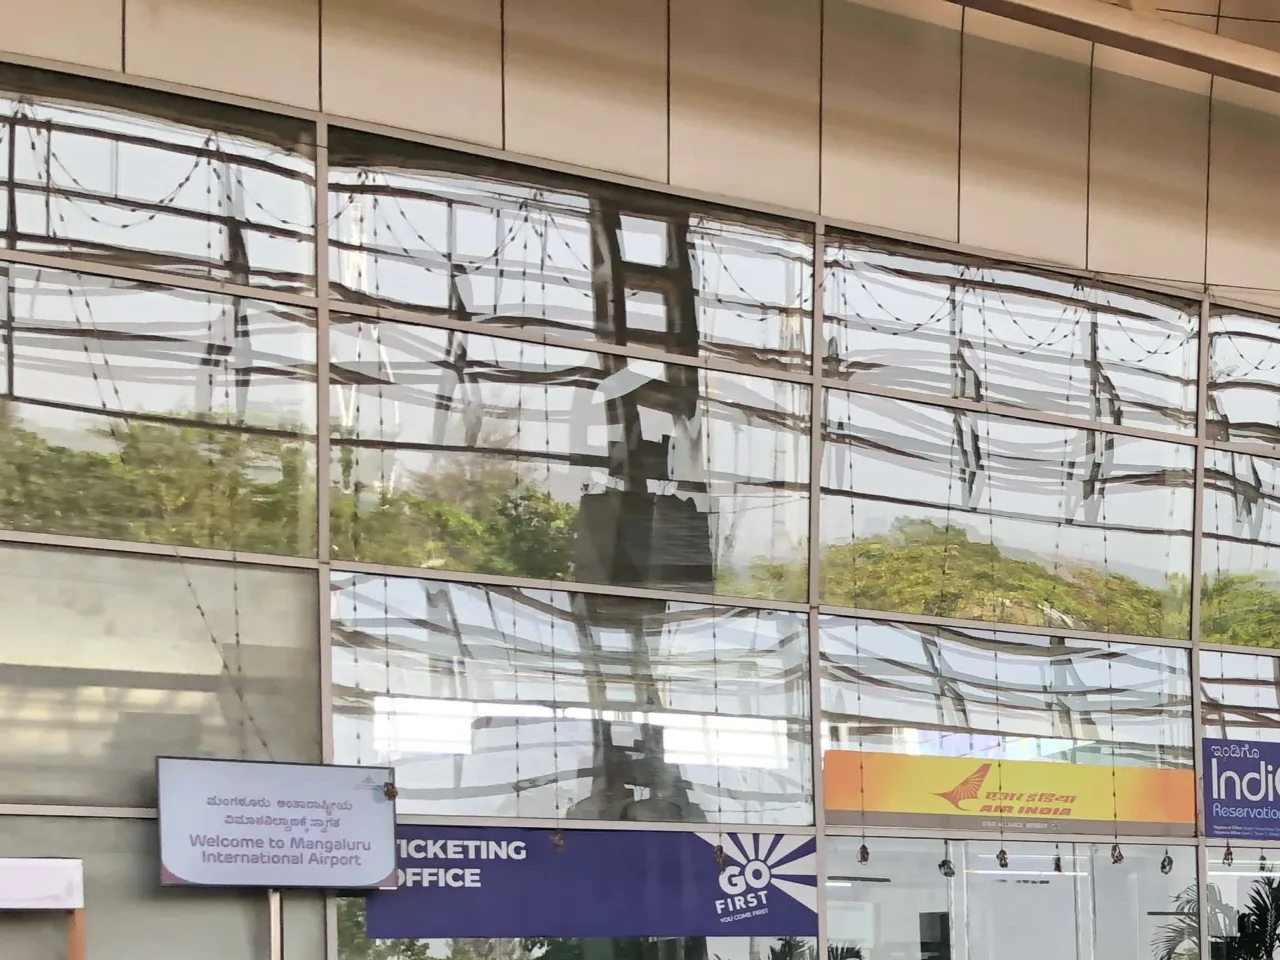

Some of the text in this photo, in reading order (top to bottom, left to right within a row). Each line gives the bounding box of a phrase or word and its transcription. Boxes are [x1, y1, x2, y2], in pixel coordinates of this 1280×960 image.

[207, 795, 272, 808] ಮಂಗಳೂರು
[979, 804, 1072, 816] AIR INDIA
[189, 834, 371, 854] Welcome to Mangaluru
[397, 839, 527, 860] ICKETING
[202, 850, 362, 869] International Airport
[718, 860, 771, 895] GO
[715, 891, 768, 914] FIRST
[734, 911, 752, 921] COME
[752, 908, 769, 917] FIRST
